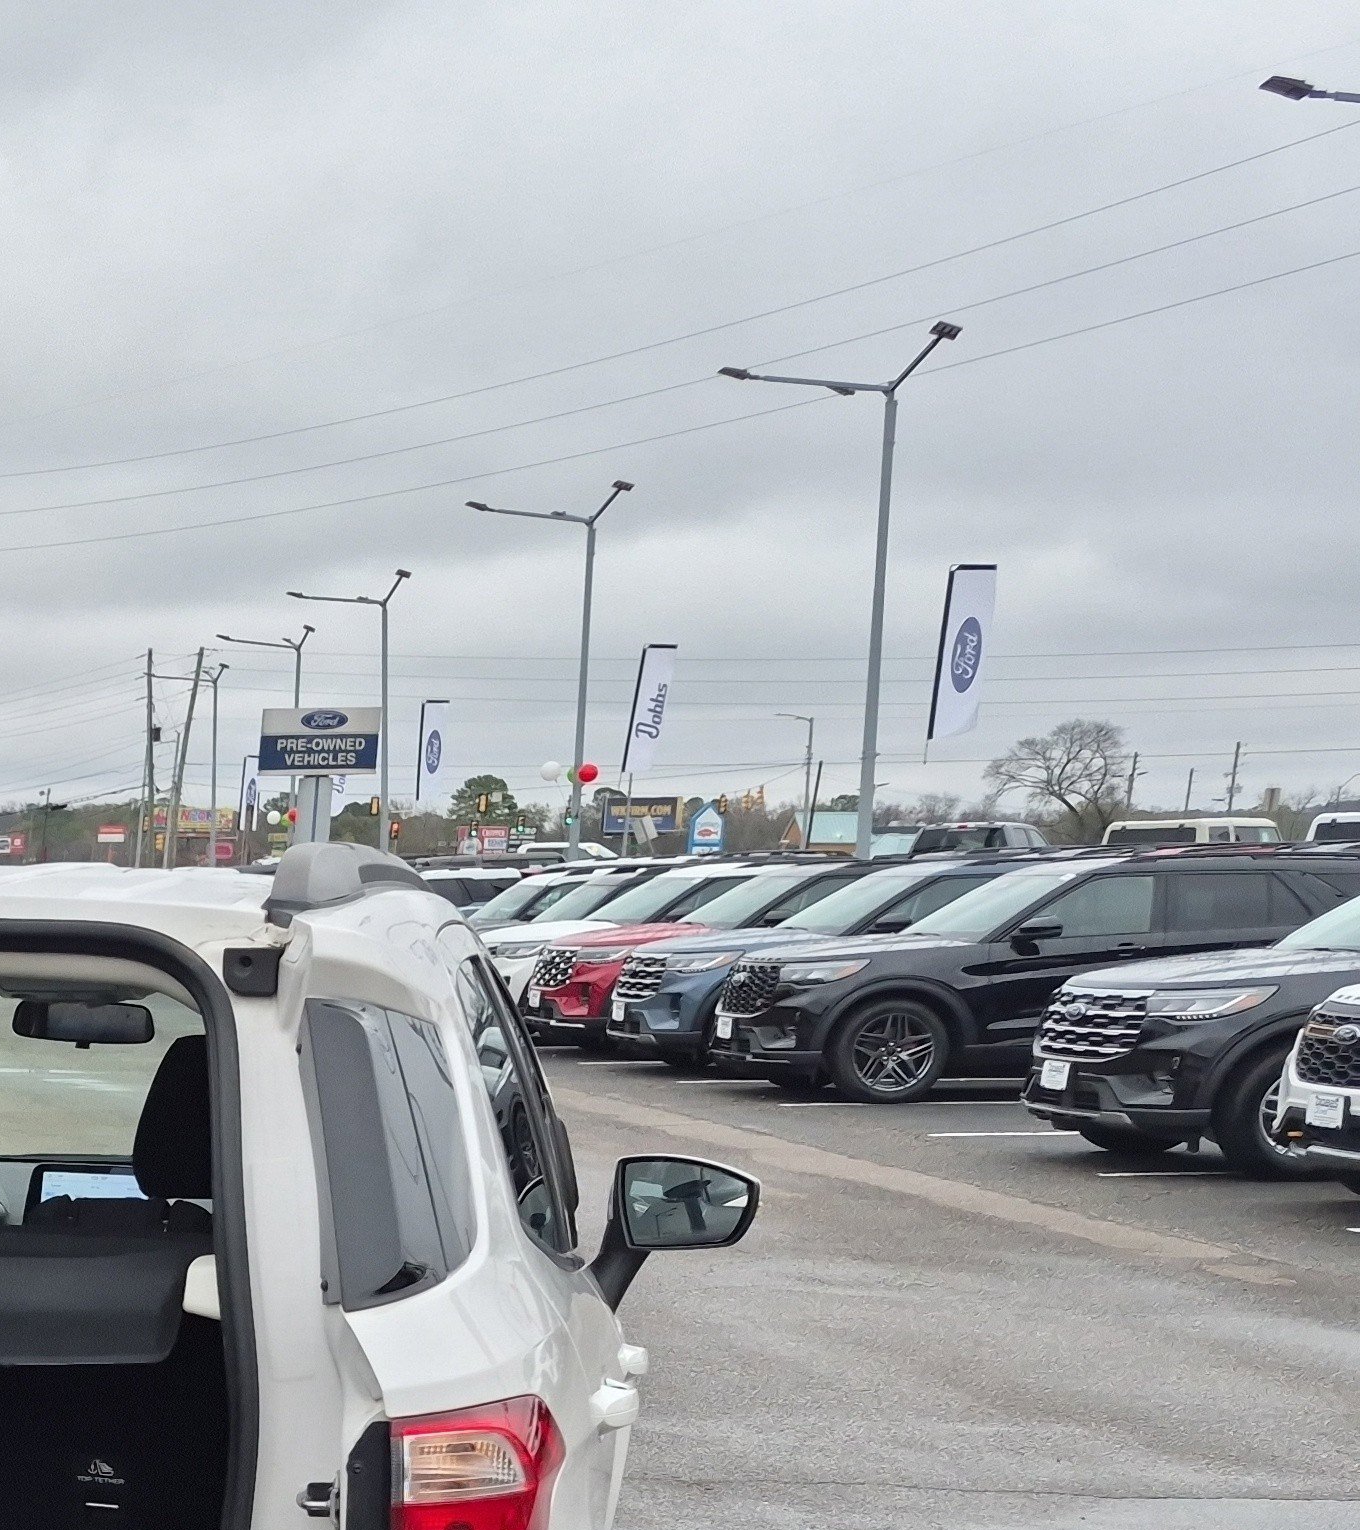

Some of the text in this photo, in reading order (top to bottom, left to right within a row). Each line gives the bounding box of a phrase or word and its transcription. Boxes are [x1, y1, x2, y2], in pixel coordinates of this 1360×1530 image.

[953, 632, 978, 679] Ford
[635, 682, 668, 740] Dobbs
[310, 713, 341, 727] Ford
[276, 738, 366, 751] PRE-OWNED
[284, 752, 356, 766] VEHICLES
